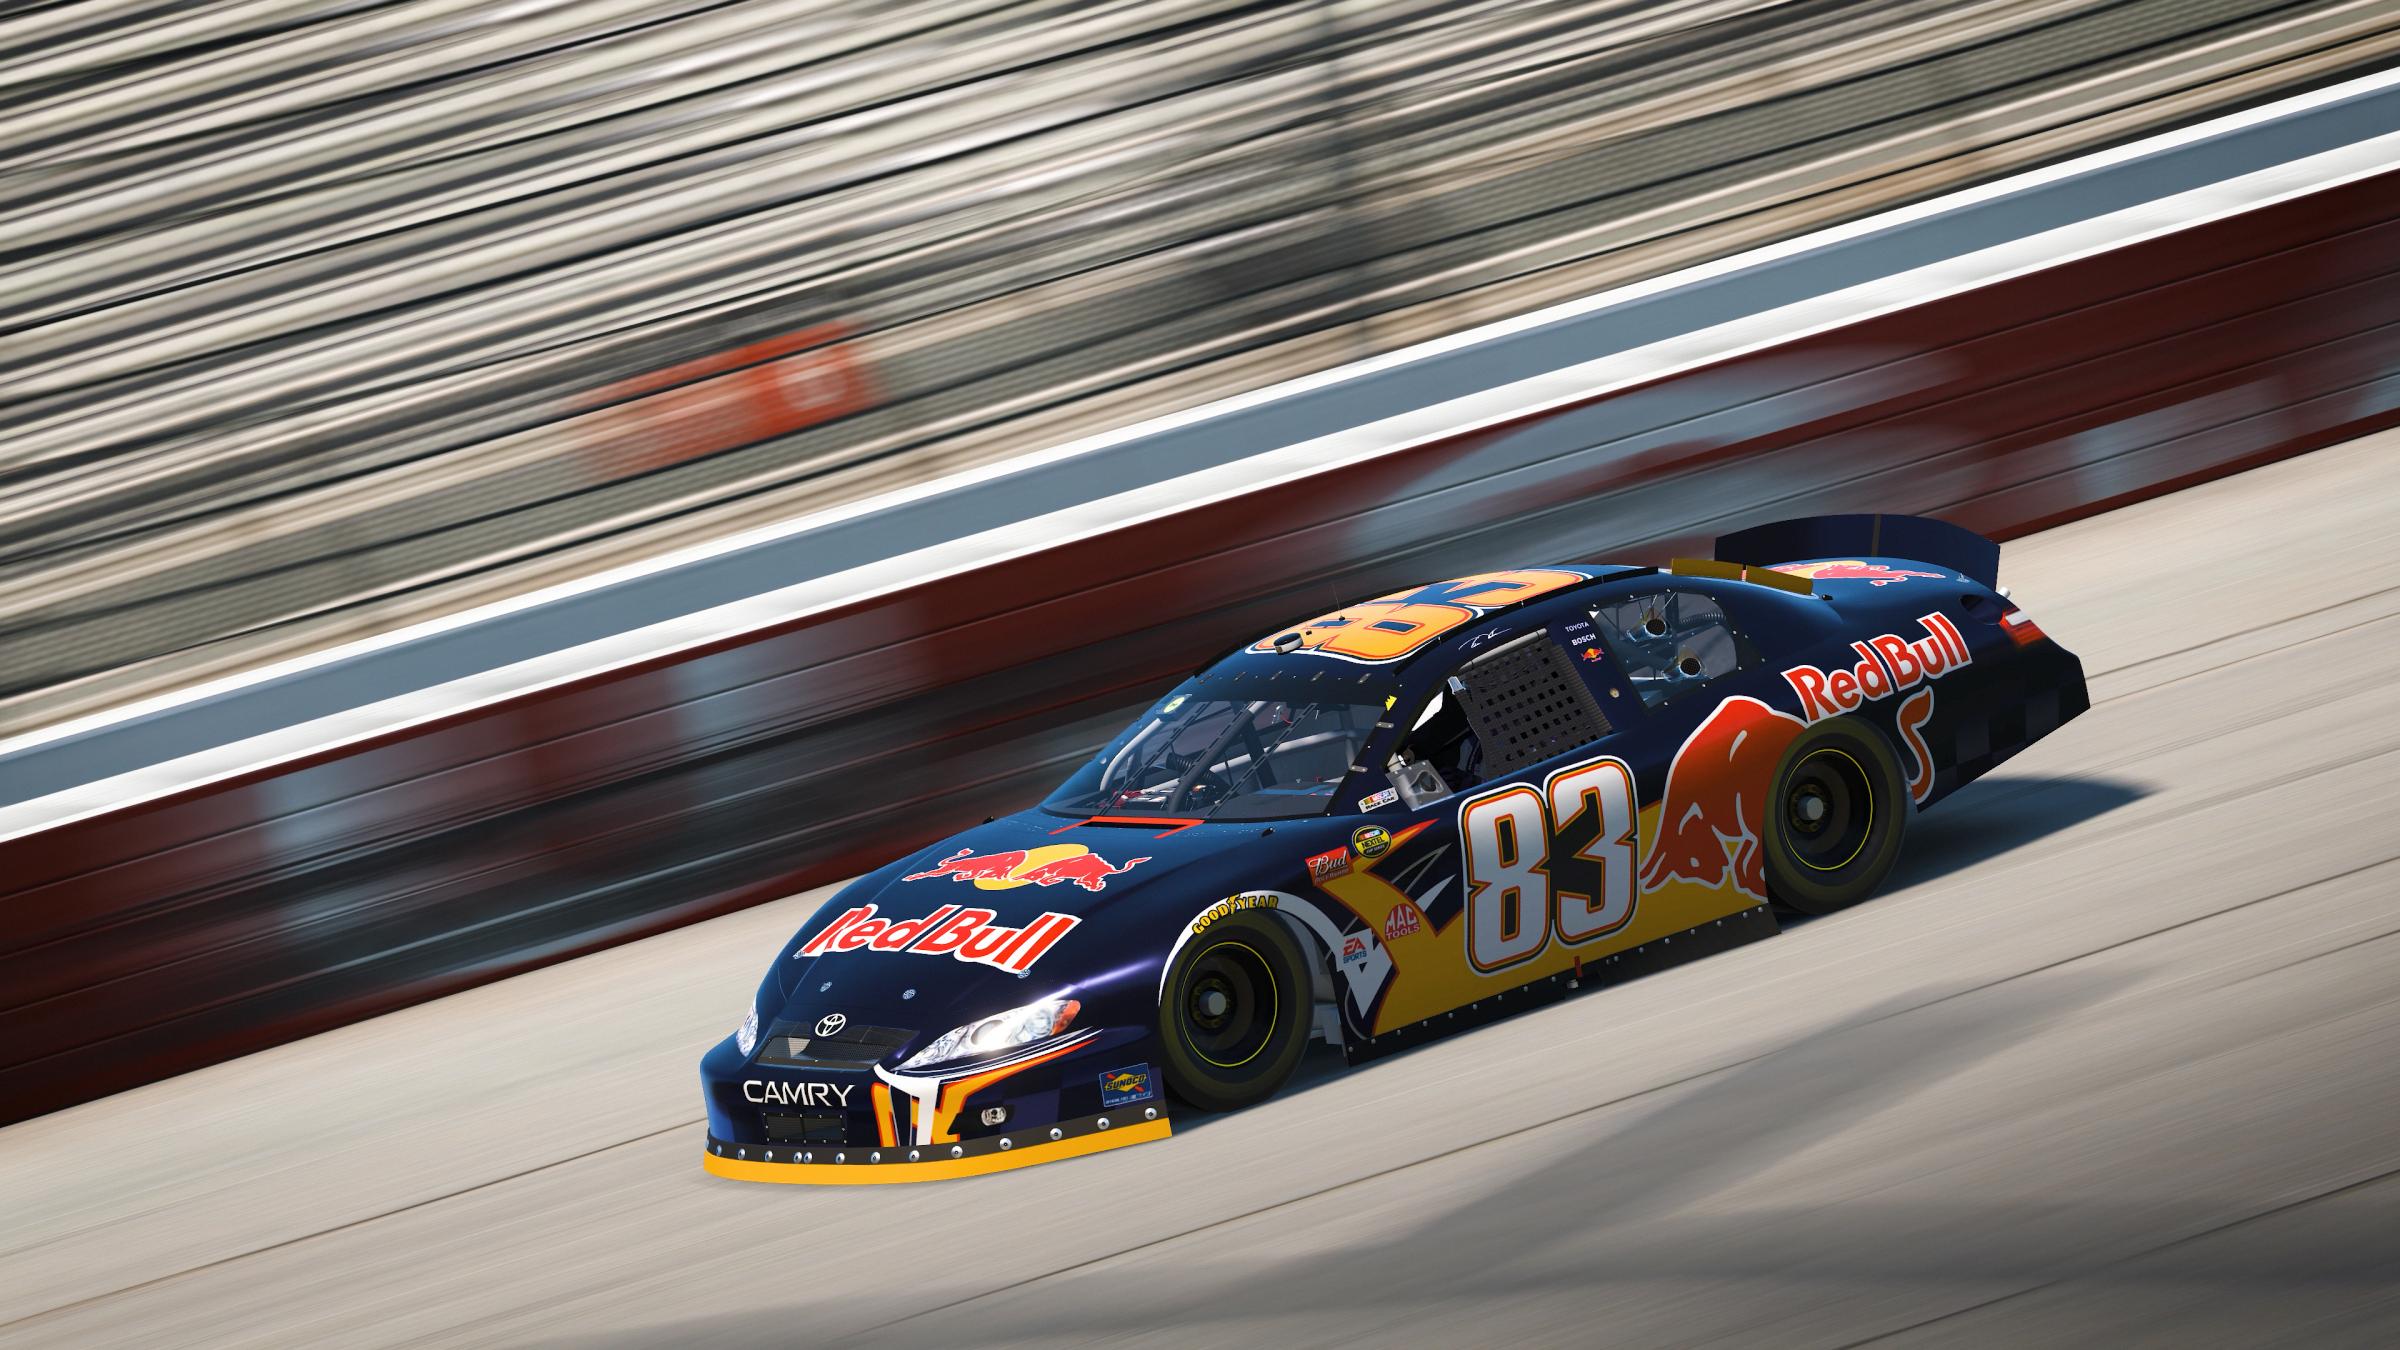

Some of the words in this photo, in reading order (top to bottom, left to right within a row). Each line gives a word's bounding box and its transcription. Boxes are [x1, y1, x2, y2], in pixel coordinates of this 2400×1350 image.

[1245, 569, 1593, 665] 83
[1565, 621, 1590, 632] TOYOTA
[1571, 633, 1597, 646] BOSCH
[1780, 640, 1895, 723] Red
[1868, 611, 1973, 691] Bull
[1361, 836, 1385, 849] NEXTEL
[1309, 849, 1347, 876] Bud
[1458, 755, 1639, 977] 83
[1386, 905, 1418, 932] MAC
[800, 904, 962, 957] Red
[905, 907, 1083, 974] Bull
[1386, 923, 1420, 940] TOOLS
[1343, 937, 1366, 956] EA
[1343, 950, 1367, 964] SPORTS
[743, 1080, 856, 1107] CAMRY
[1104, 1074, 1147, 1091] SUNOCO
